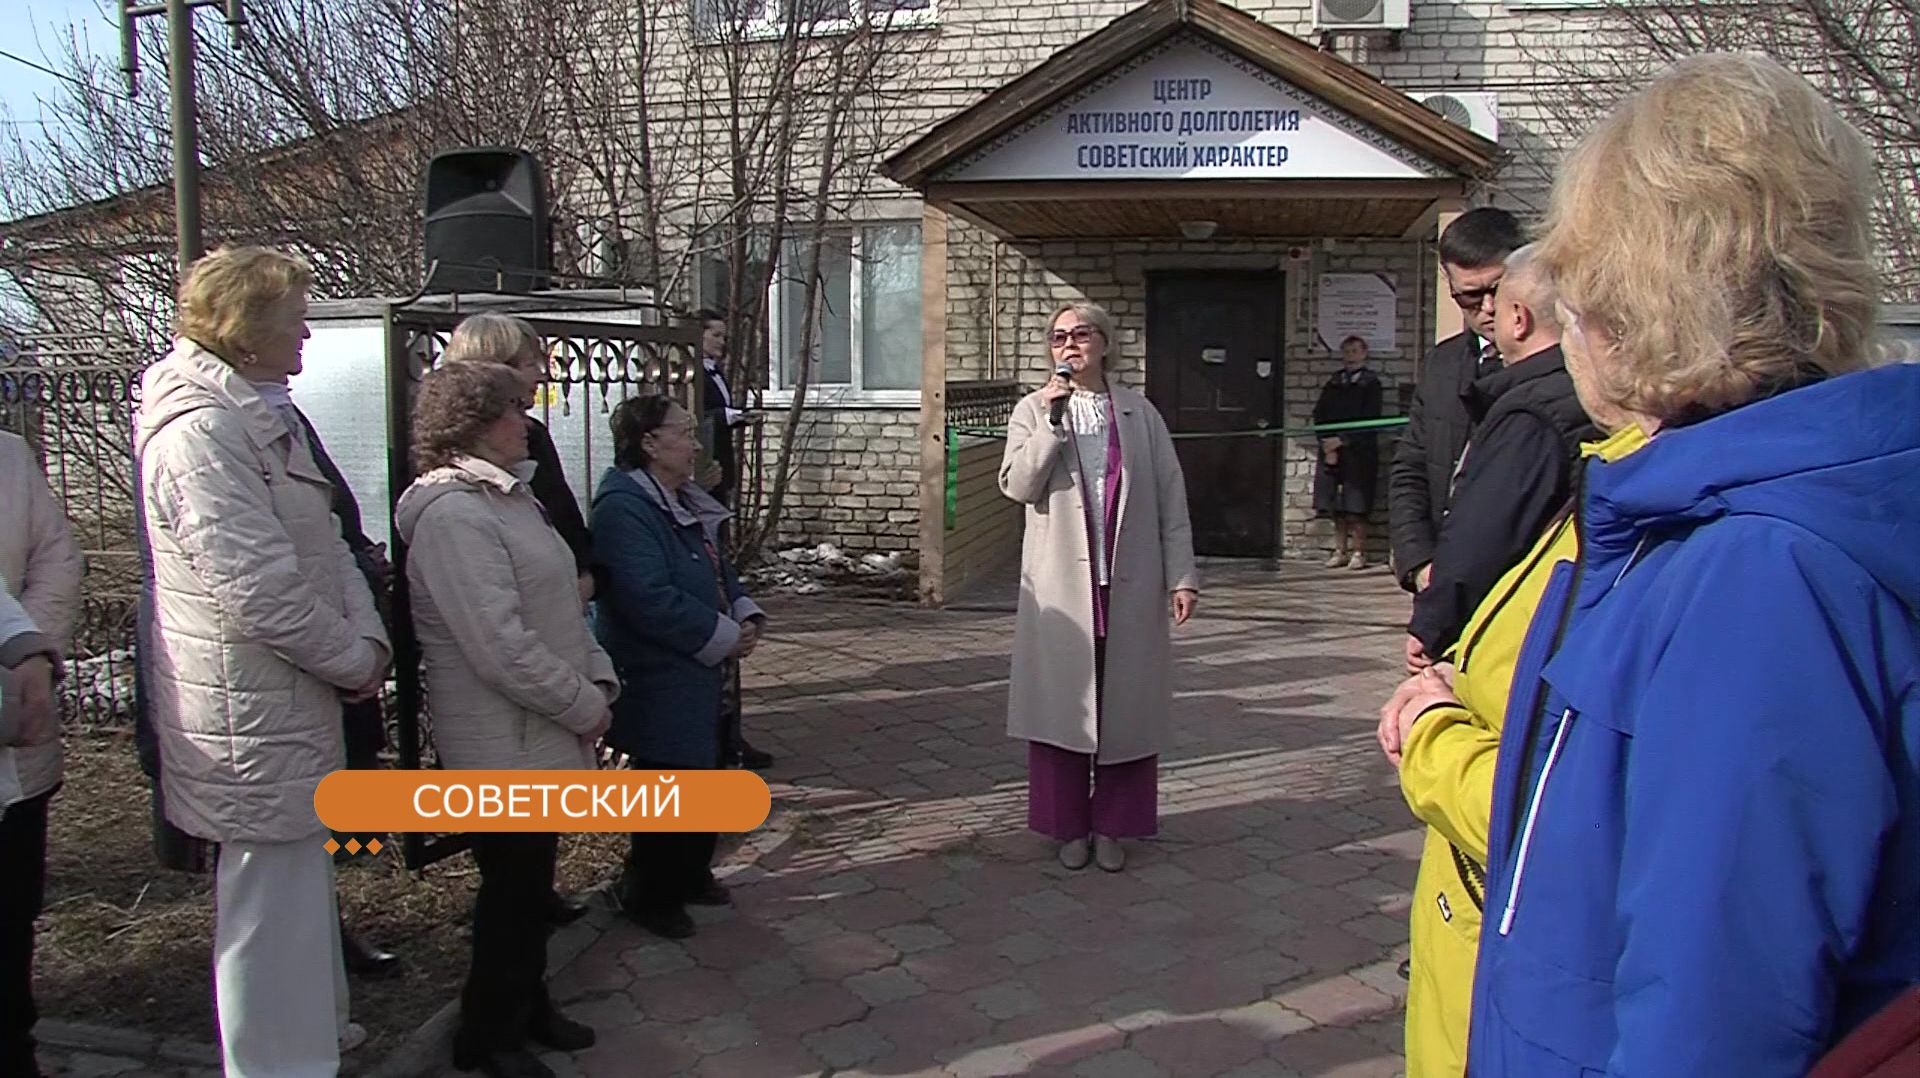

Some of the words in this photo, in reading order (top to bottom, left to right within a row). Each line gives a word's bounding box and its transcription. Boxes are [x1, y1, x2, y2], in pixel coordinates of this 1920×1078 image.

[1153, 79, 1211, 104] ЦЕНТР
[1067, 111, 1173, 134] АКТИВНОГО
[1178, 109, 1300, 136] ДОЛГОЛЕТИЯ
[1192, 145, 1289, 168] ХАРАКТЕР
